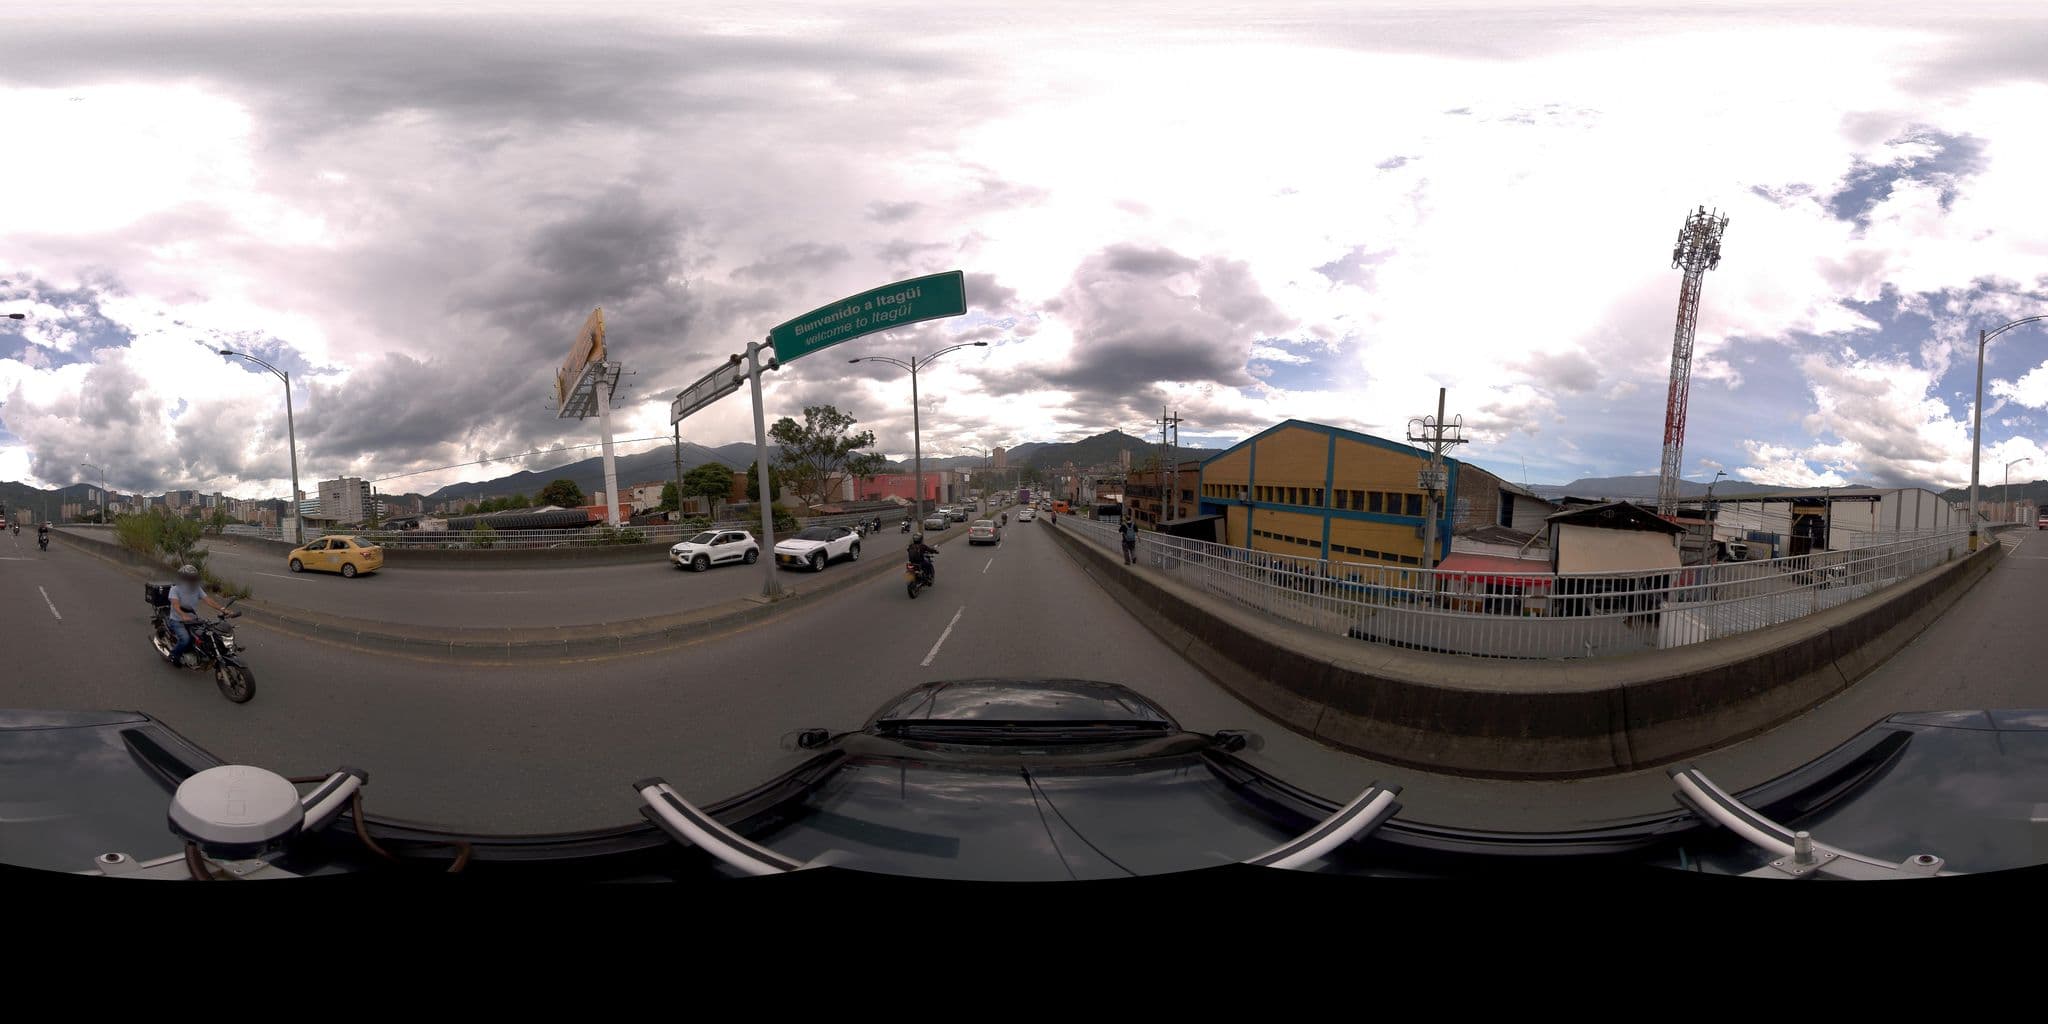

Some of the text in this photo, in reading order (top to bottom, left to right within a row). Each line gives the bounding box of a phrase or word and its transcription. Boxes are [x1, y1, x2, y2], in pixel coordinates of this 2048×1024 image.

[864, 301, 873, 311] a
[877, 286, 922, 307] Itagüi
[856, 318, 868, 330] to
